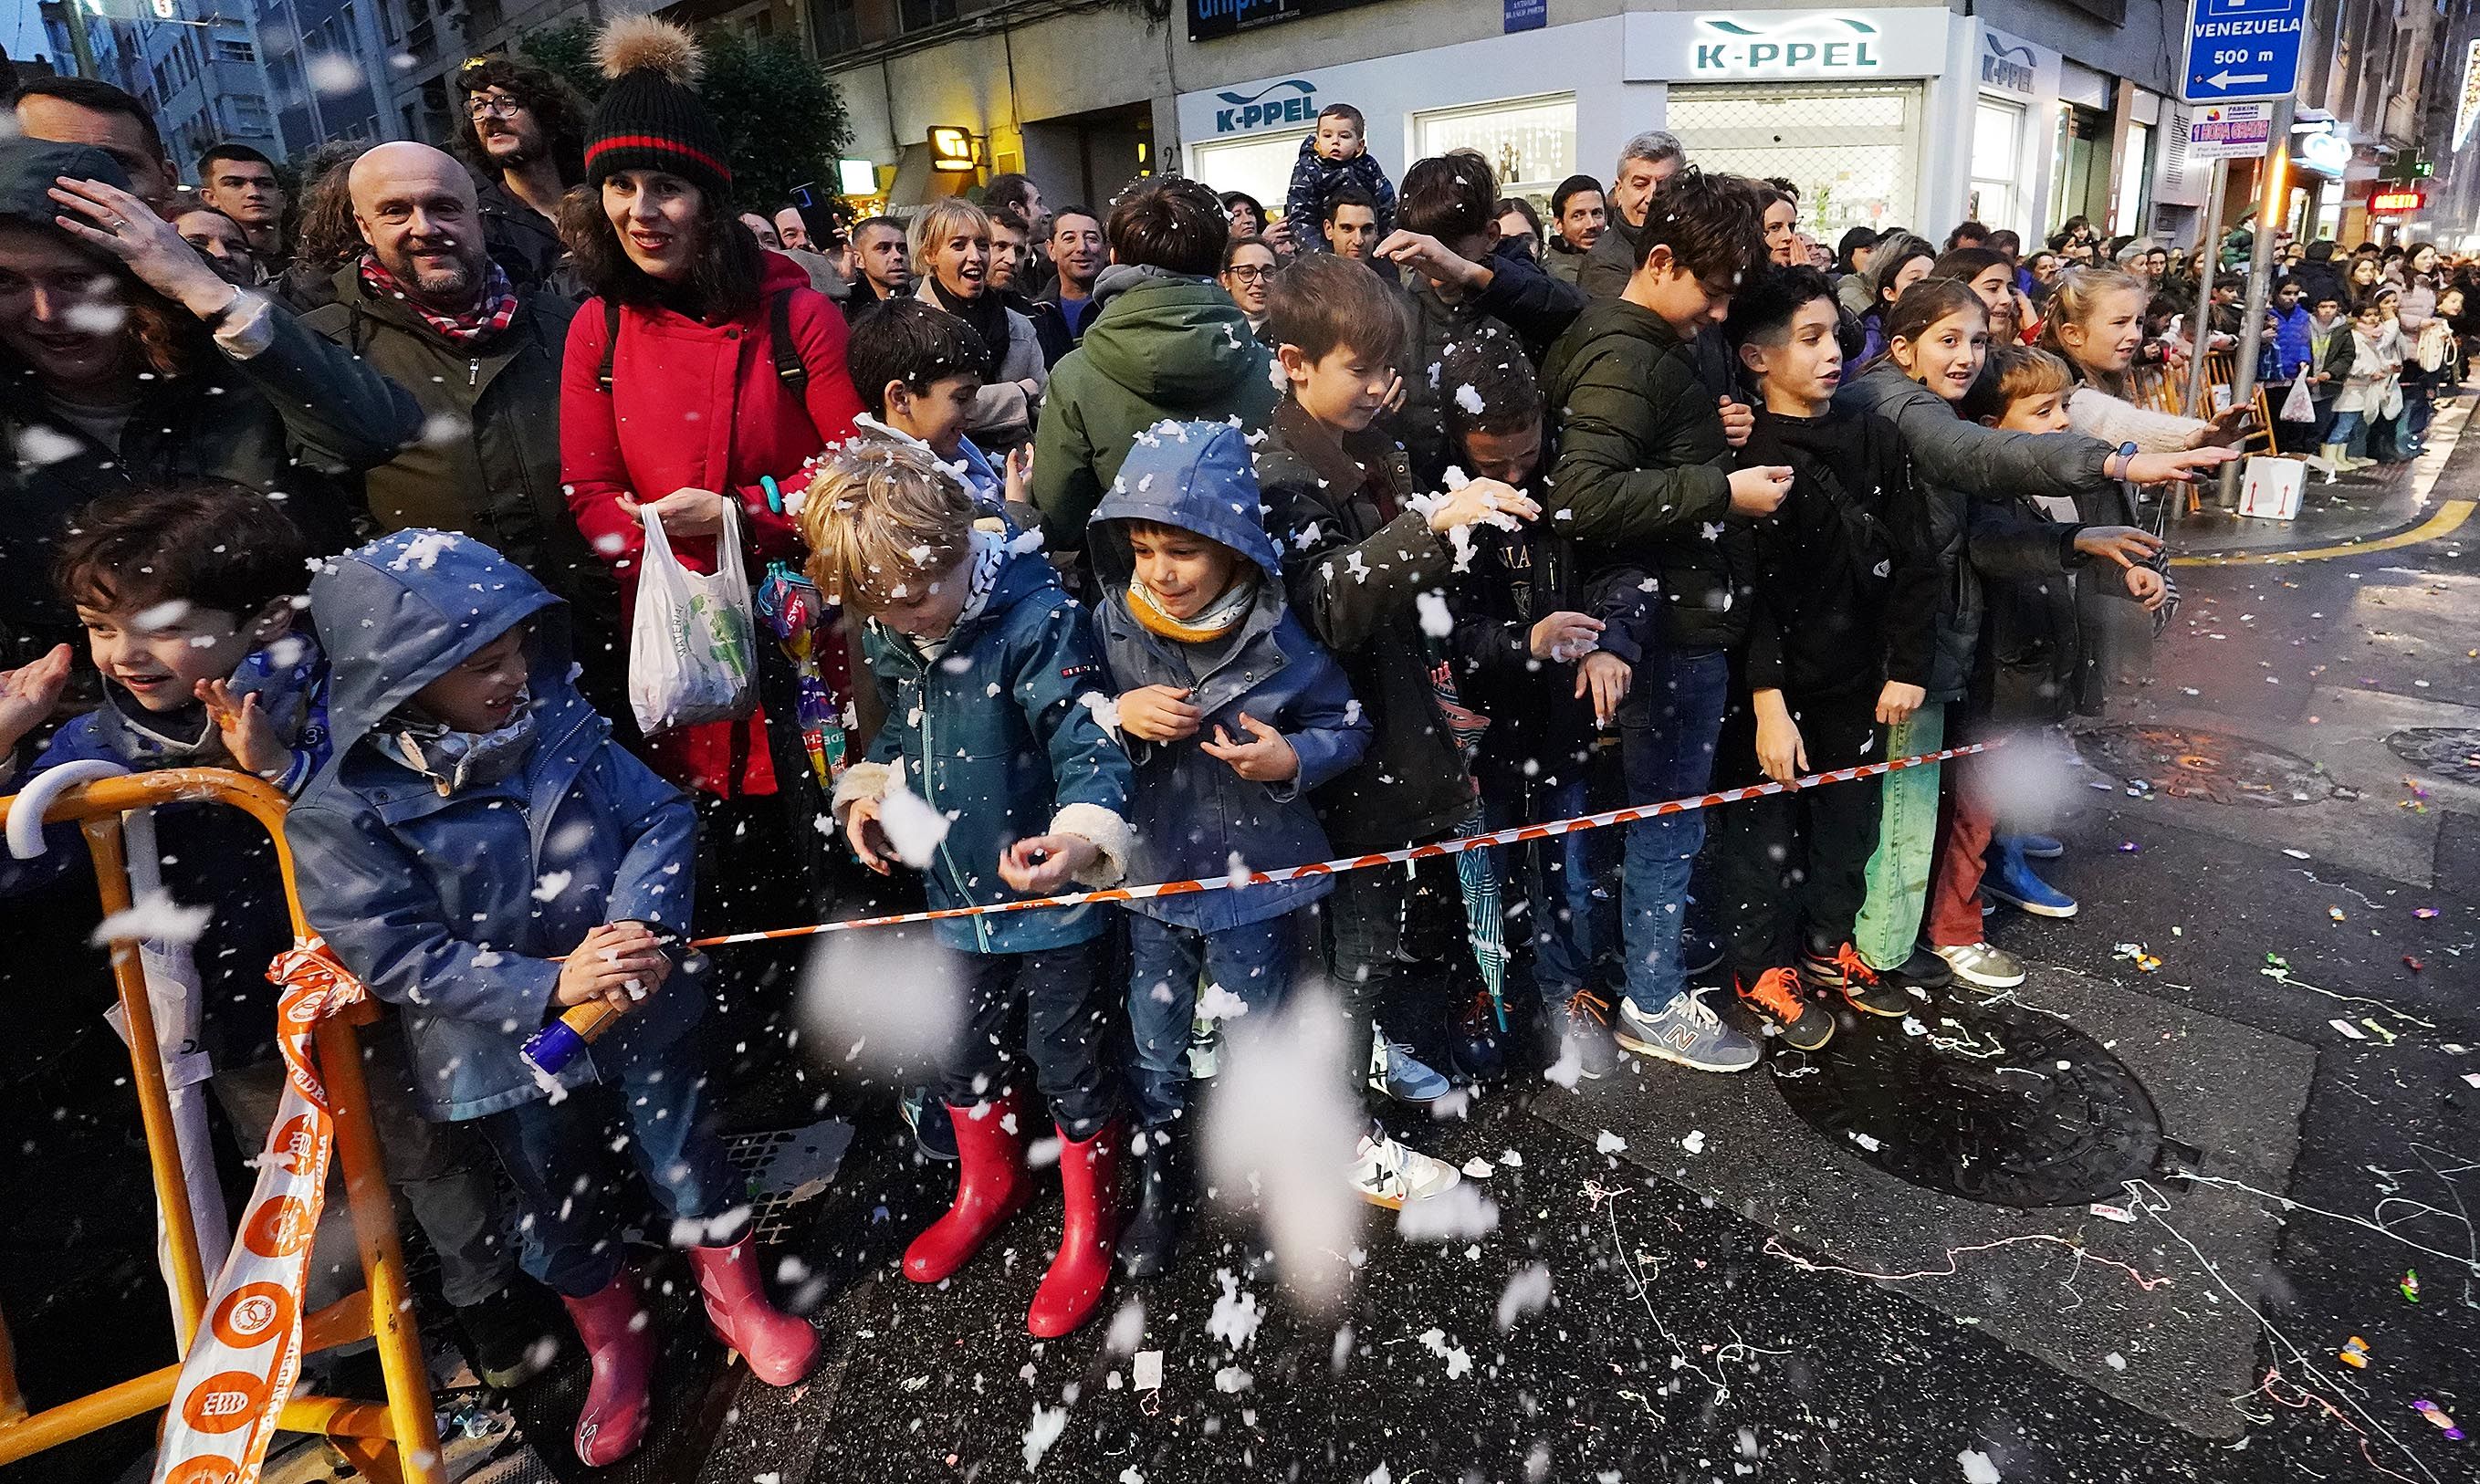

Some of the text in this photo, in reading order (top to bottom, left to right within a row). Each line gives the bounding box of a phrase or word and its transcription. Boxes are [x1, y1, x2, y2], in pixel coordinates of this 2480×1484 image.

[2194, 17, 2300, 37] VENEZUELA
[1698, 42, 1877, 68] K-PPEL
[2213, 48, 2273, 64] 500 m
[1216, 96, 1318, 132] K-PPEL
[2193, 120, 2268, 141] 1 HORA GRATIS
[1663, 1023, 1700, 1051] N
